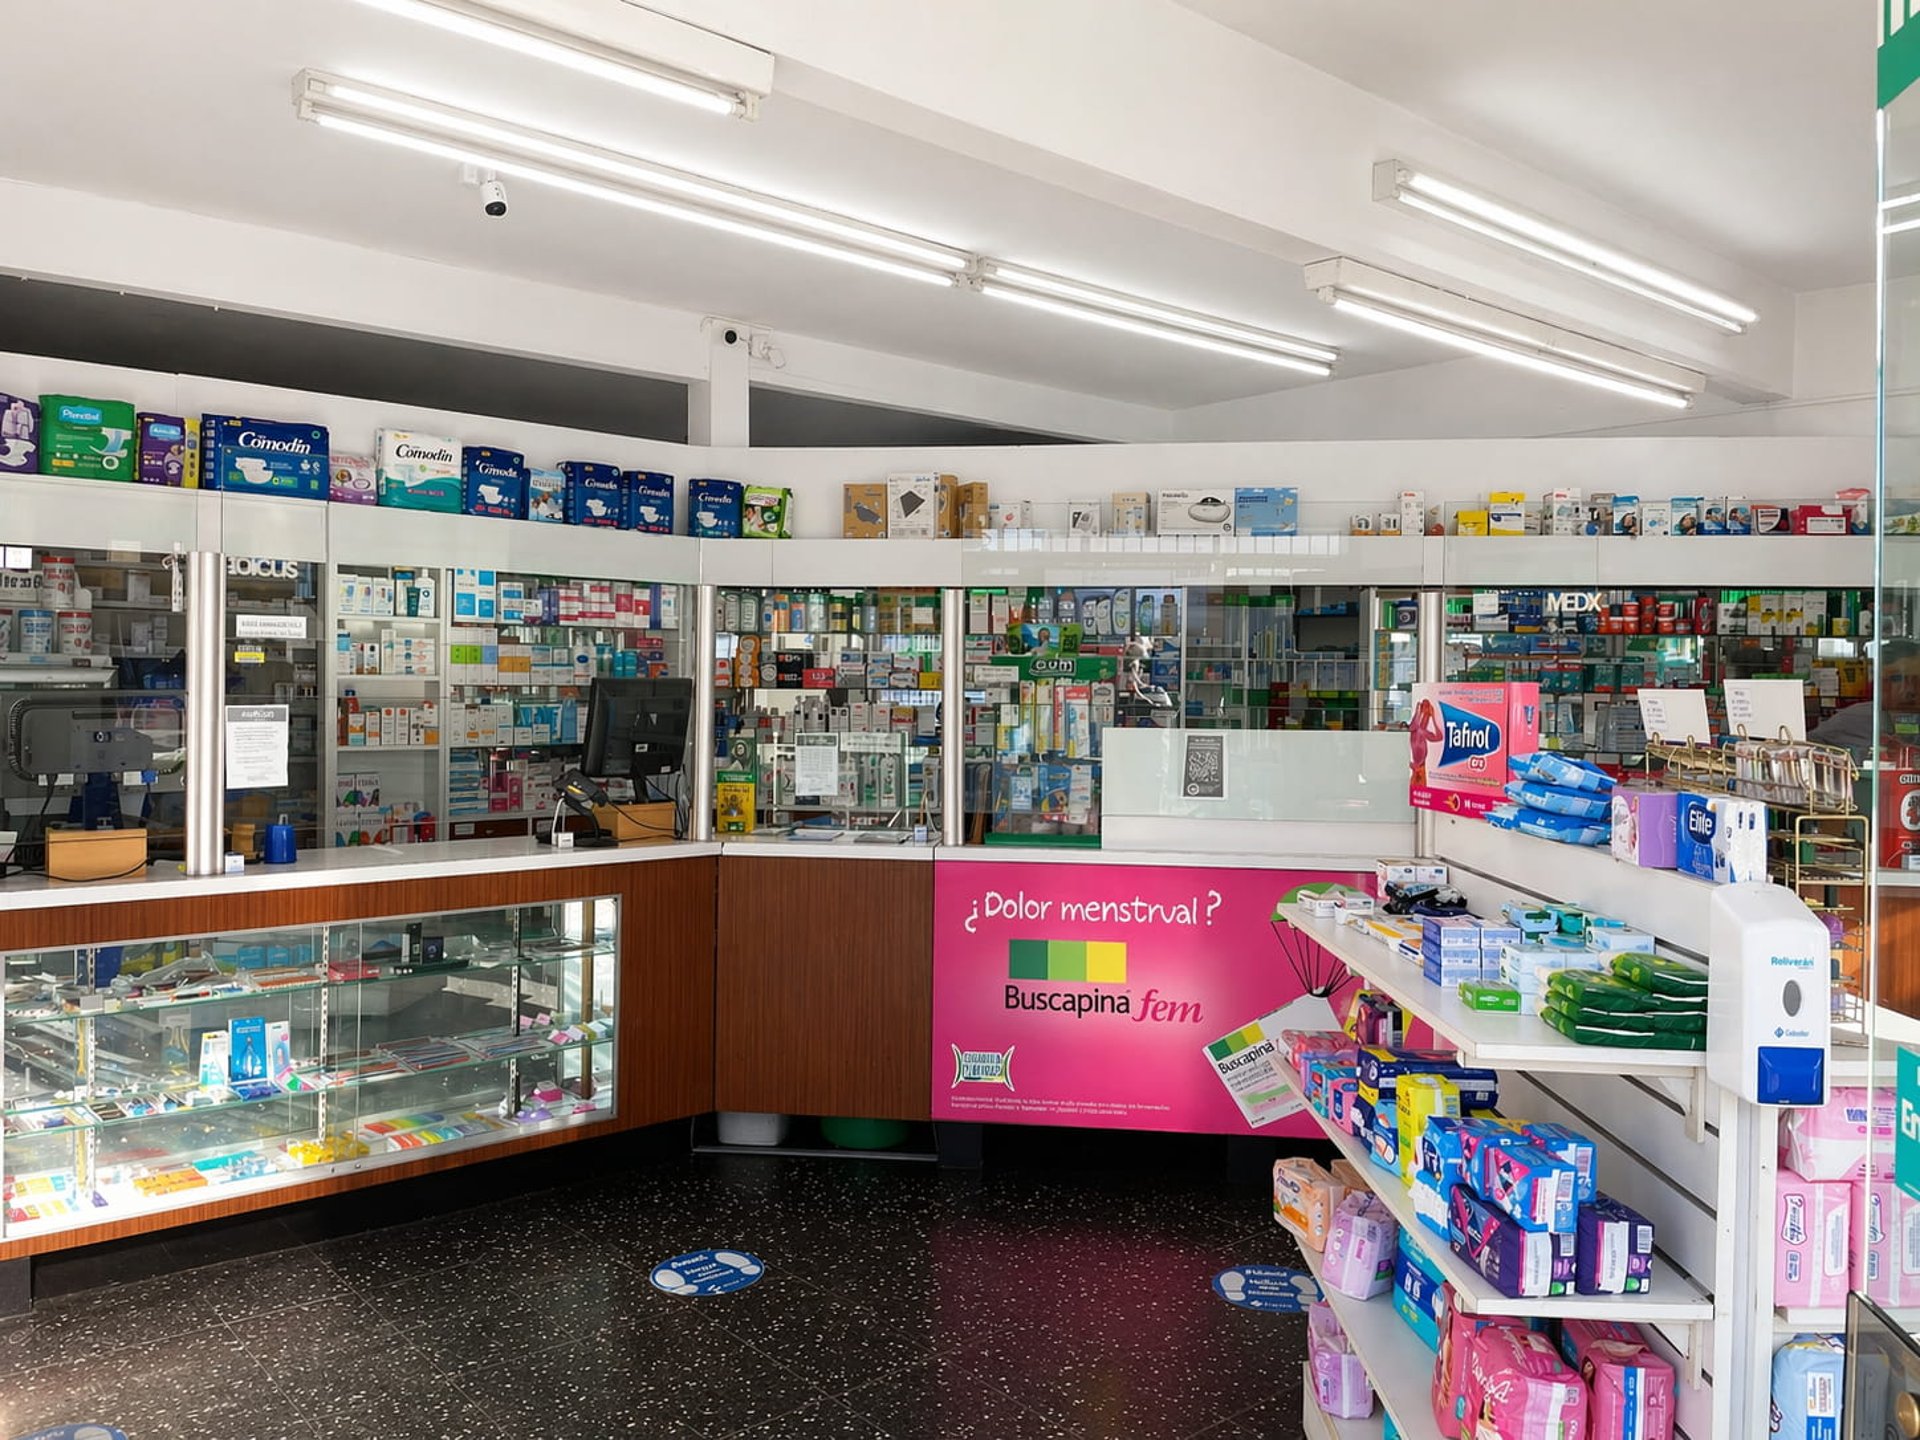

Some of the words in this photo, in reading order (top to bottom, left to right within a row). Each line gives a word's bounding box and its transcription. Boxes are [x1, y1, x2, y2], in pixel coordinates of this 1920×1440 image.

[1547, 592, 1602, 612] MEDX
[1446, 721, 1491, 751] Tafirol
[1004, 984, 1131, 1019] Buscapina
[1131, 988, 1204, 1023] fem
